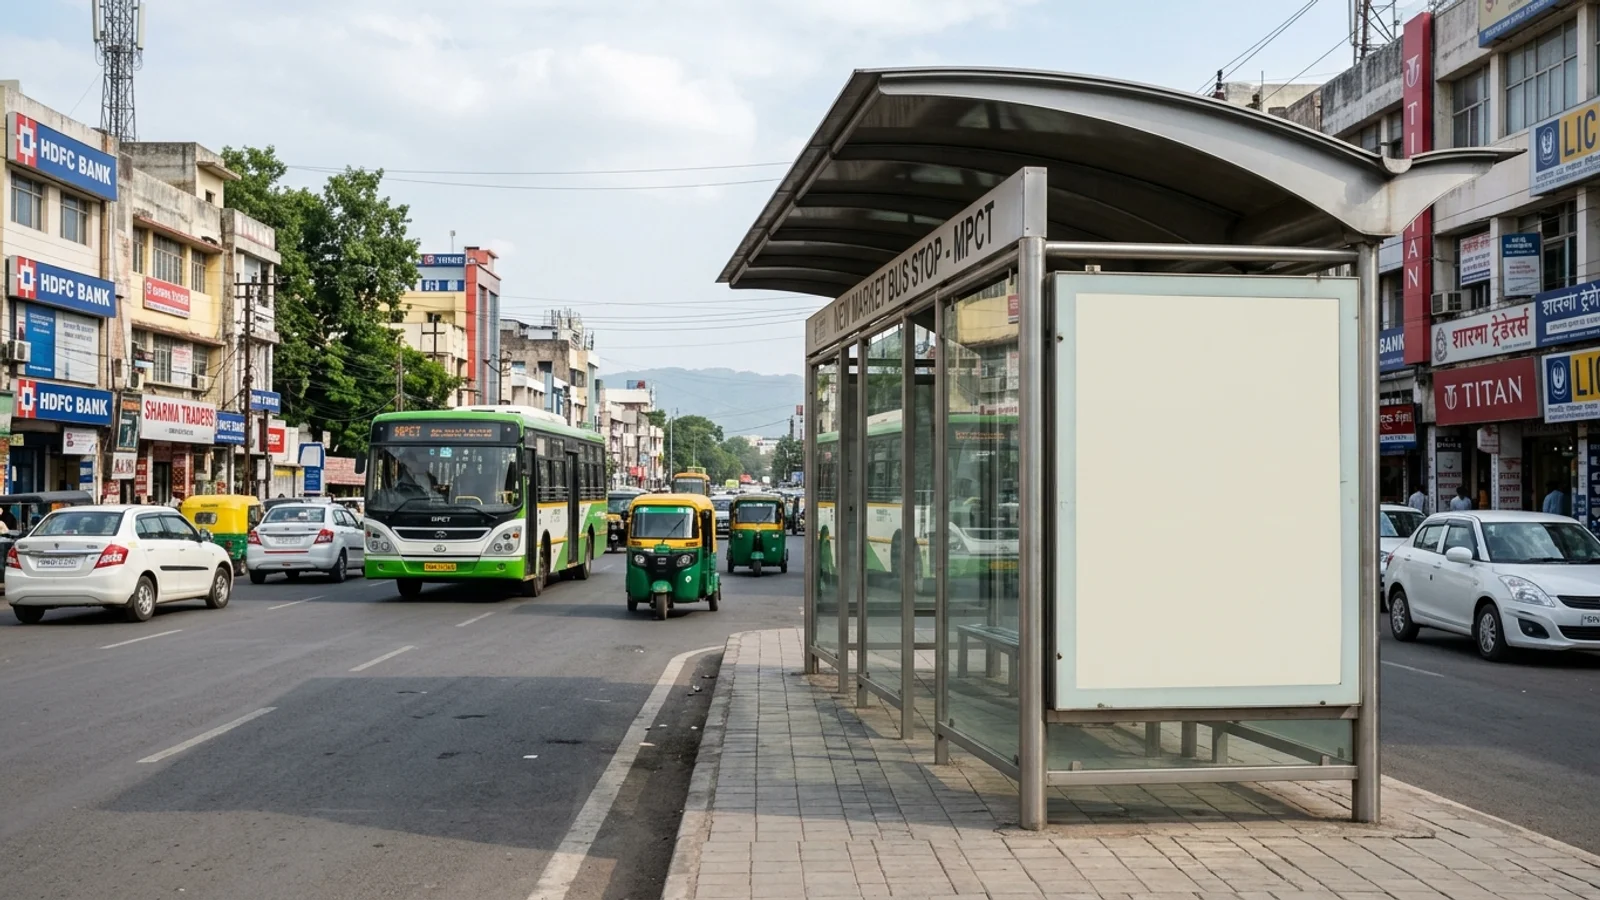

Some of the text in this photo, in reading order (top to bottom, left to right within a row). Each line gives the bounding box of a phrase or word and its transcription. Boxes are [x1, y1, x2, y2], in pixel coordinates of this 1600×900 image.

[1564, 109, 1596, 157] LIC
[40, 138, 111, 186] HDFC BANK
[833, 296, 850, 334] NEW
[852, 274, 887, 324] MARKET
[888, 259, 909, 302] BUS
[911, 236, 942, 287] STOP
[953, 200, 995, 264] MPCT
[40, 273, 110, 307] HDFC BANK
[1379, 333, 1405, 354] BANK
[39, 392, 73, 412] HDFC
[76, 395, 108, 416] BANK
[1462, 375, 1523, 408] TITAN
[144, 399, 180, 423] SHARMA
[181, 405, 214, 427] TRADERS
